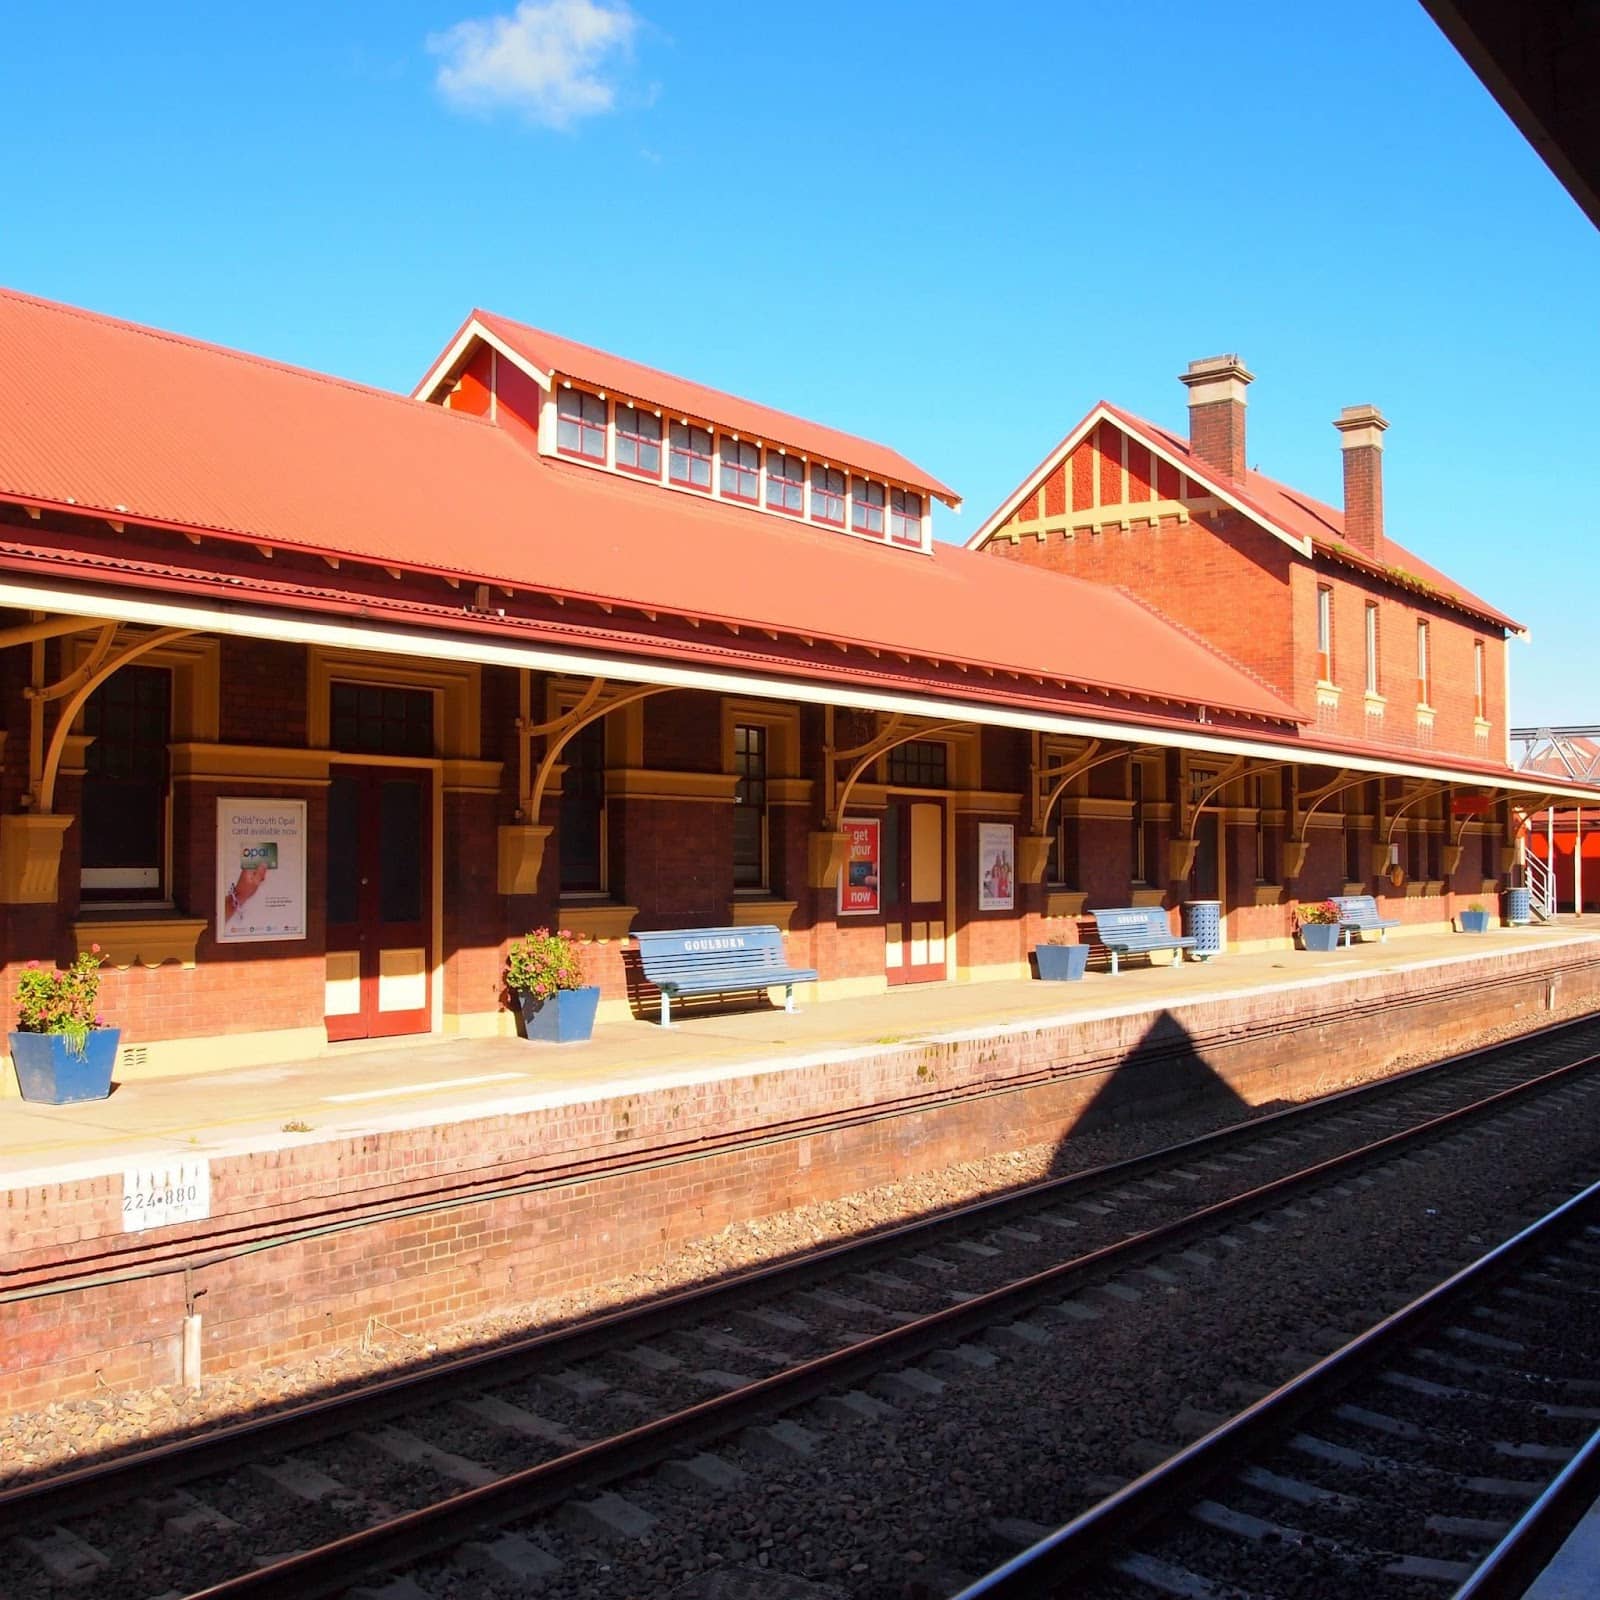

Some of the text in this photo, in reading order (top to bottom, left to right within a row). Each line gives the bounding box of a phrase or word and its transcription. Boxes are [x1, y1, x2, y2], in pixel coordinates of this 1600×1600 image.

[232, 827, 249, 836] card
[250, 827, 281, 836] available
[853, 829, 868, 844] get
[243, 847, 269, 860] opal
[850, 845, 871, 857] your
[851, 891, 871, 903] now
[684, 936, 745, 951] GOULBURN
